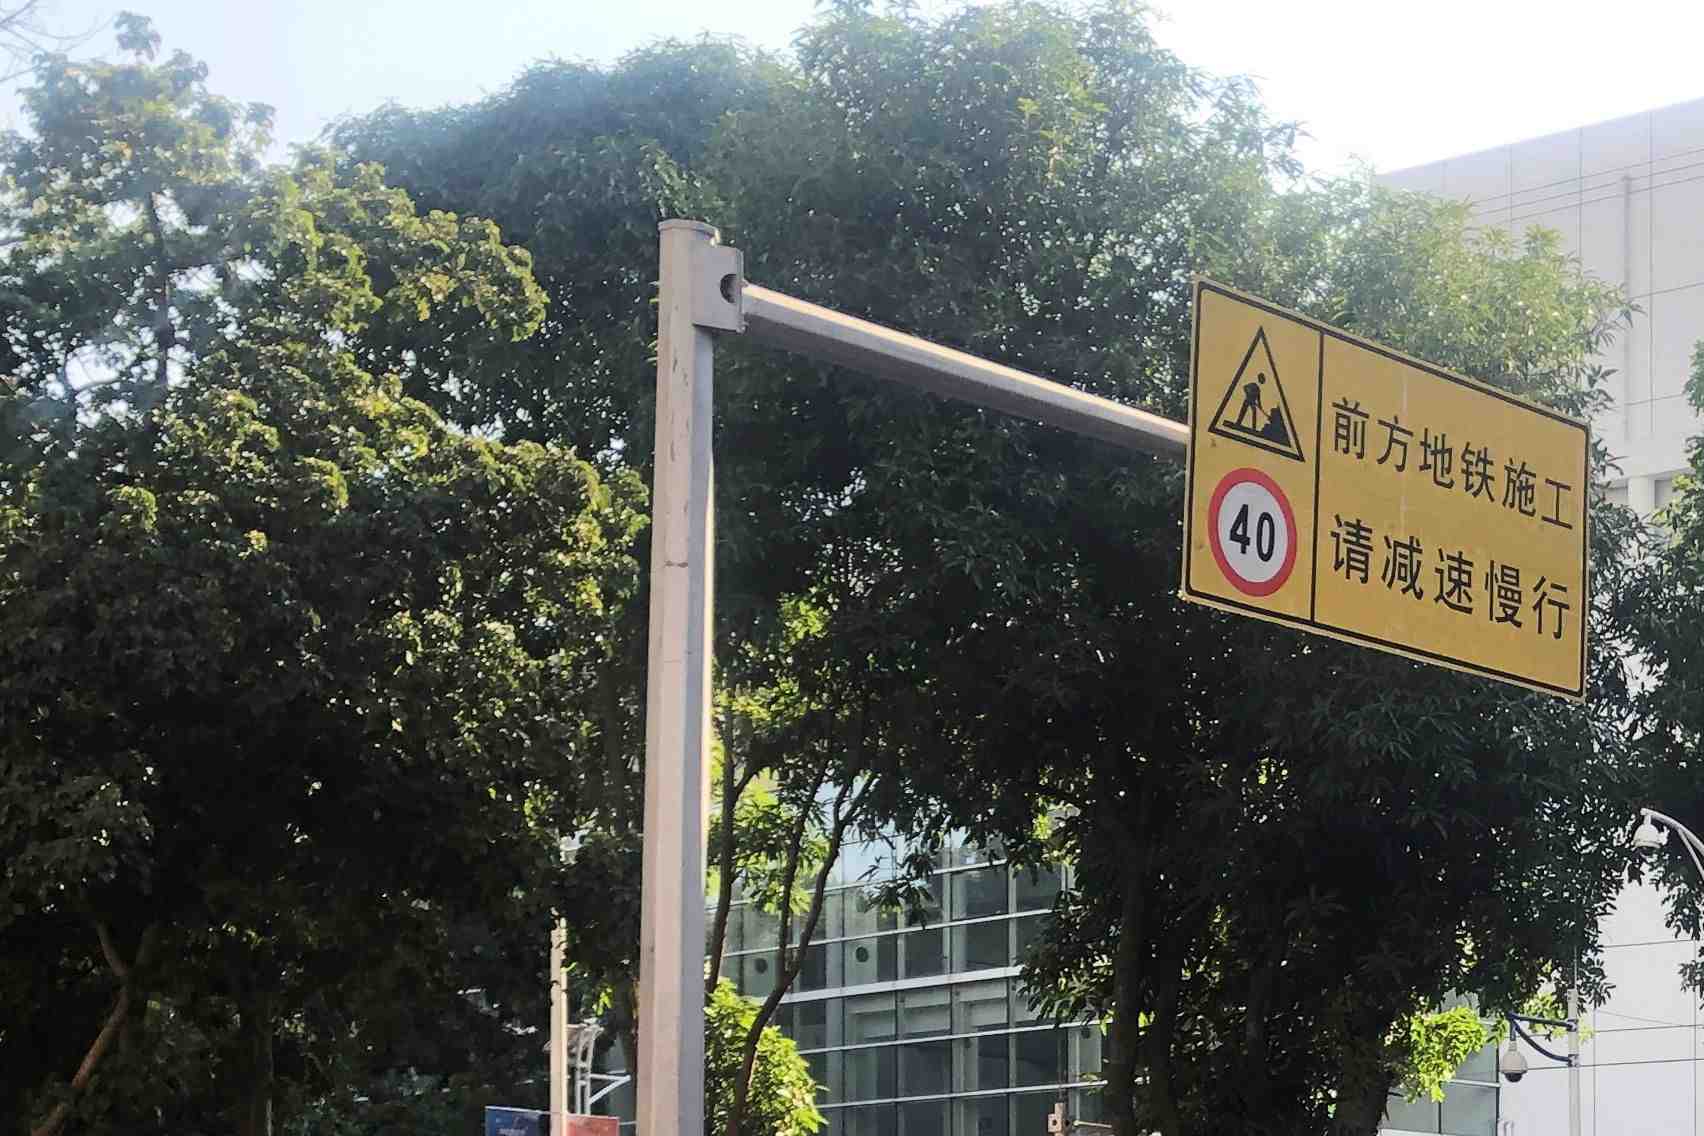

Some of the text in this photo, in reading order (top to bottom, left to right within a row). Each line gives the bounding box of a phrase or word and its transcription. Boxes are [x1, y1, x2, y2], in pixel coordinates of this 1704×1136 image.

[1332, 397, 1574, 530] 前方地铁施工
[1229, 503, 1275, 562] 40
[1331, 513, 1570, 640] 请减速慢行
